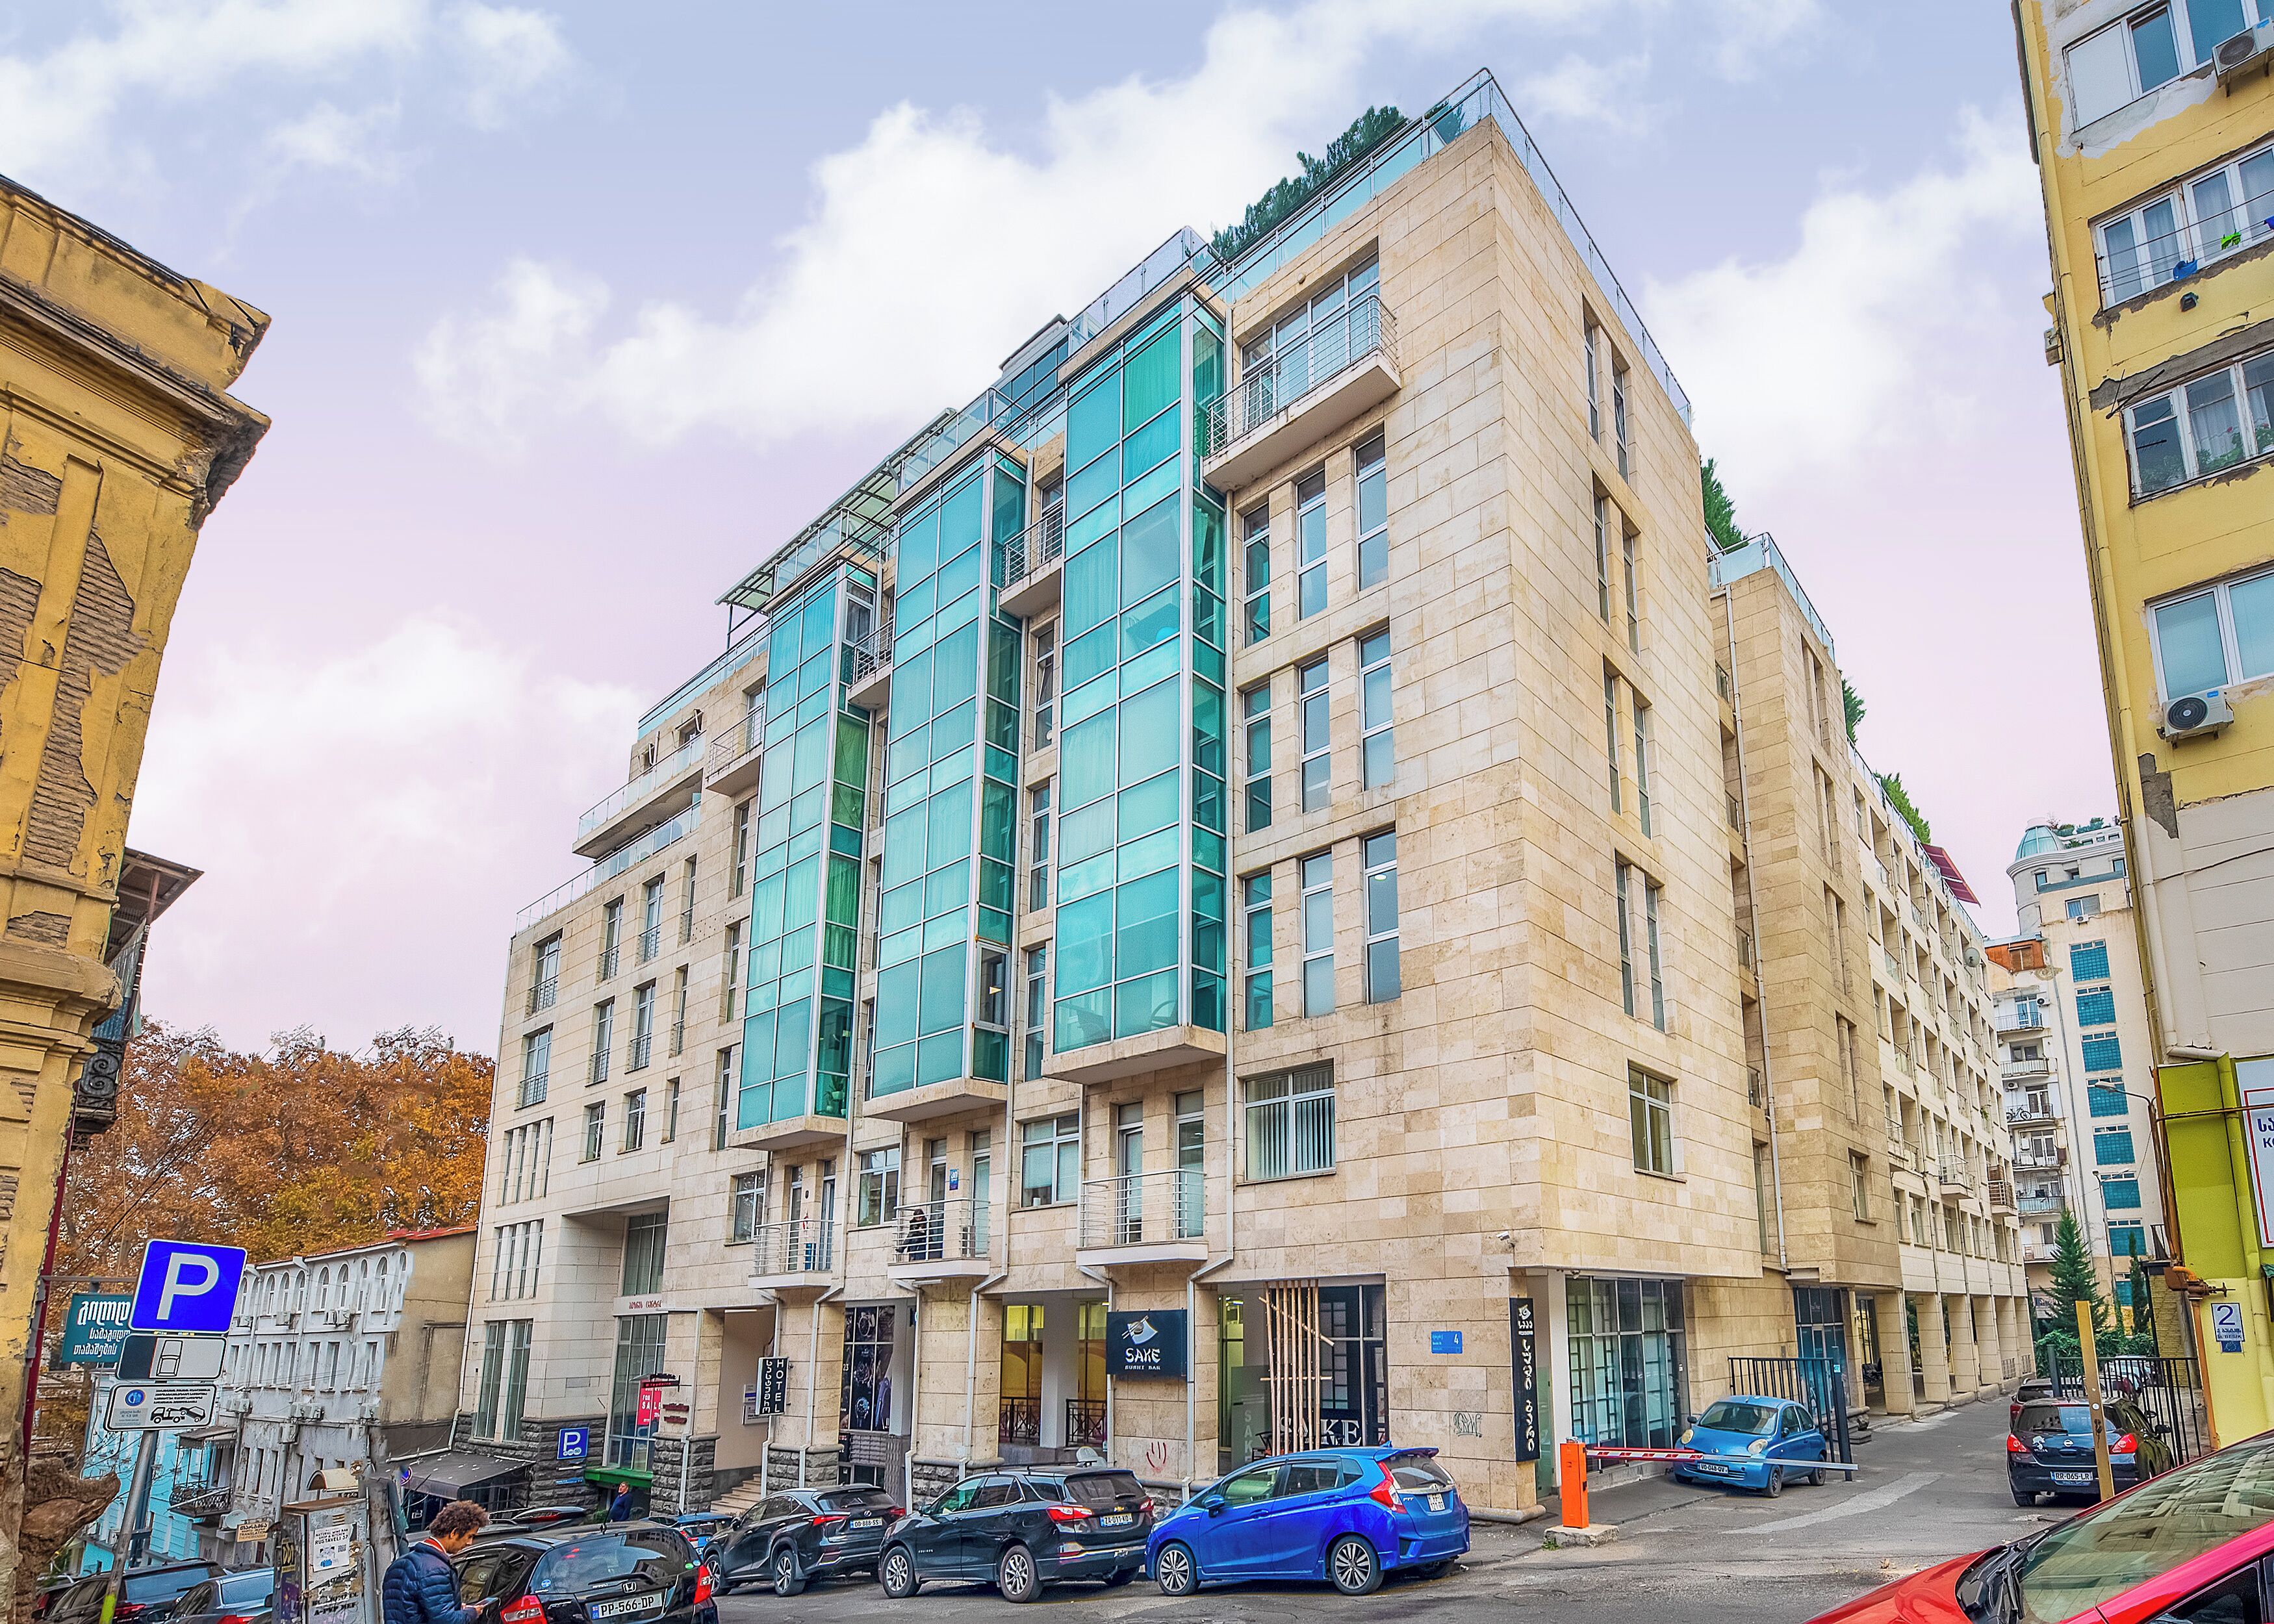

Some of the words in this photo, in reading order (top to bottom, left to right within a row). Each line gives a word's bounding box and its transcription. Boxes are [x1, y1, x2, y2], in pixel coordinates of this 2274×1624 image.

[157, 1252, 219, 1320] P
[77, 1300, 131, 1326] გილდ
[2217, 1305, 2235, 1325] 2
[1454, 1334, 1459, 1344] 4
[73, 1343, 118, 1358] თამაშების
[1125, 1348, 1161, 1363] SAKE
[774, 1359, 784, 1413] HOTEL
[563, 1431, 581, 1451] P
[314, 1536, 341, 1545] RUSTAVELI
[600, 1596, 654, 1616] PP-566-DP
